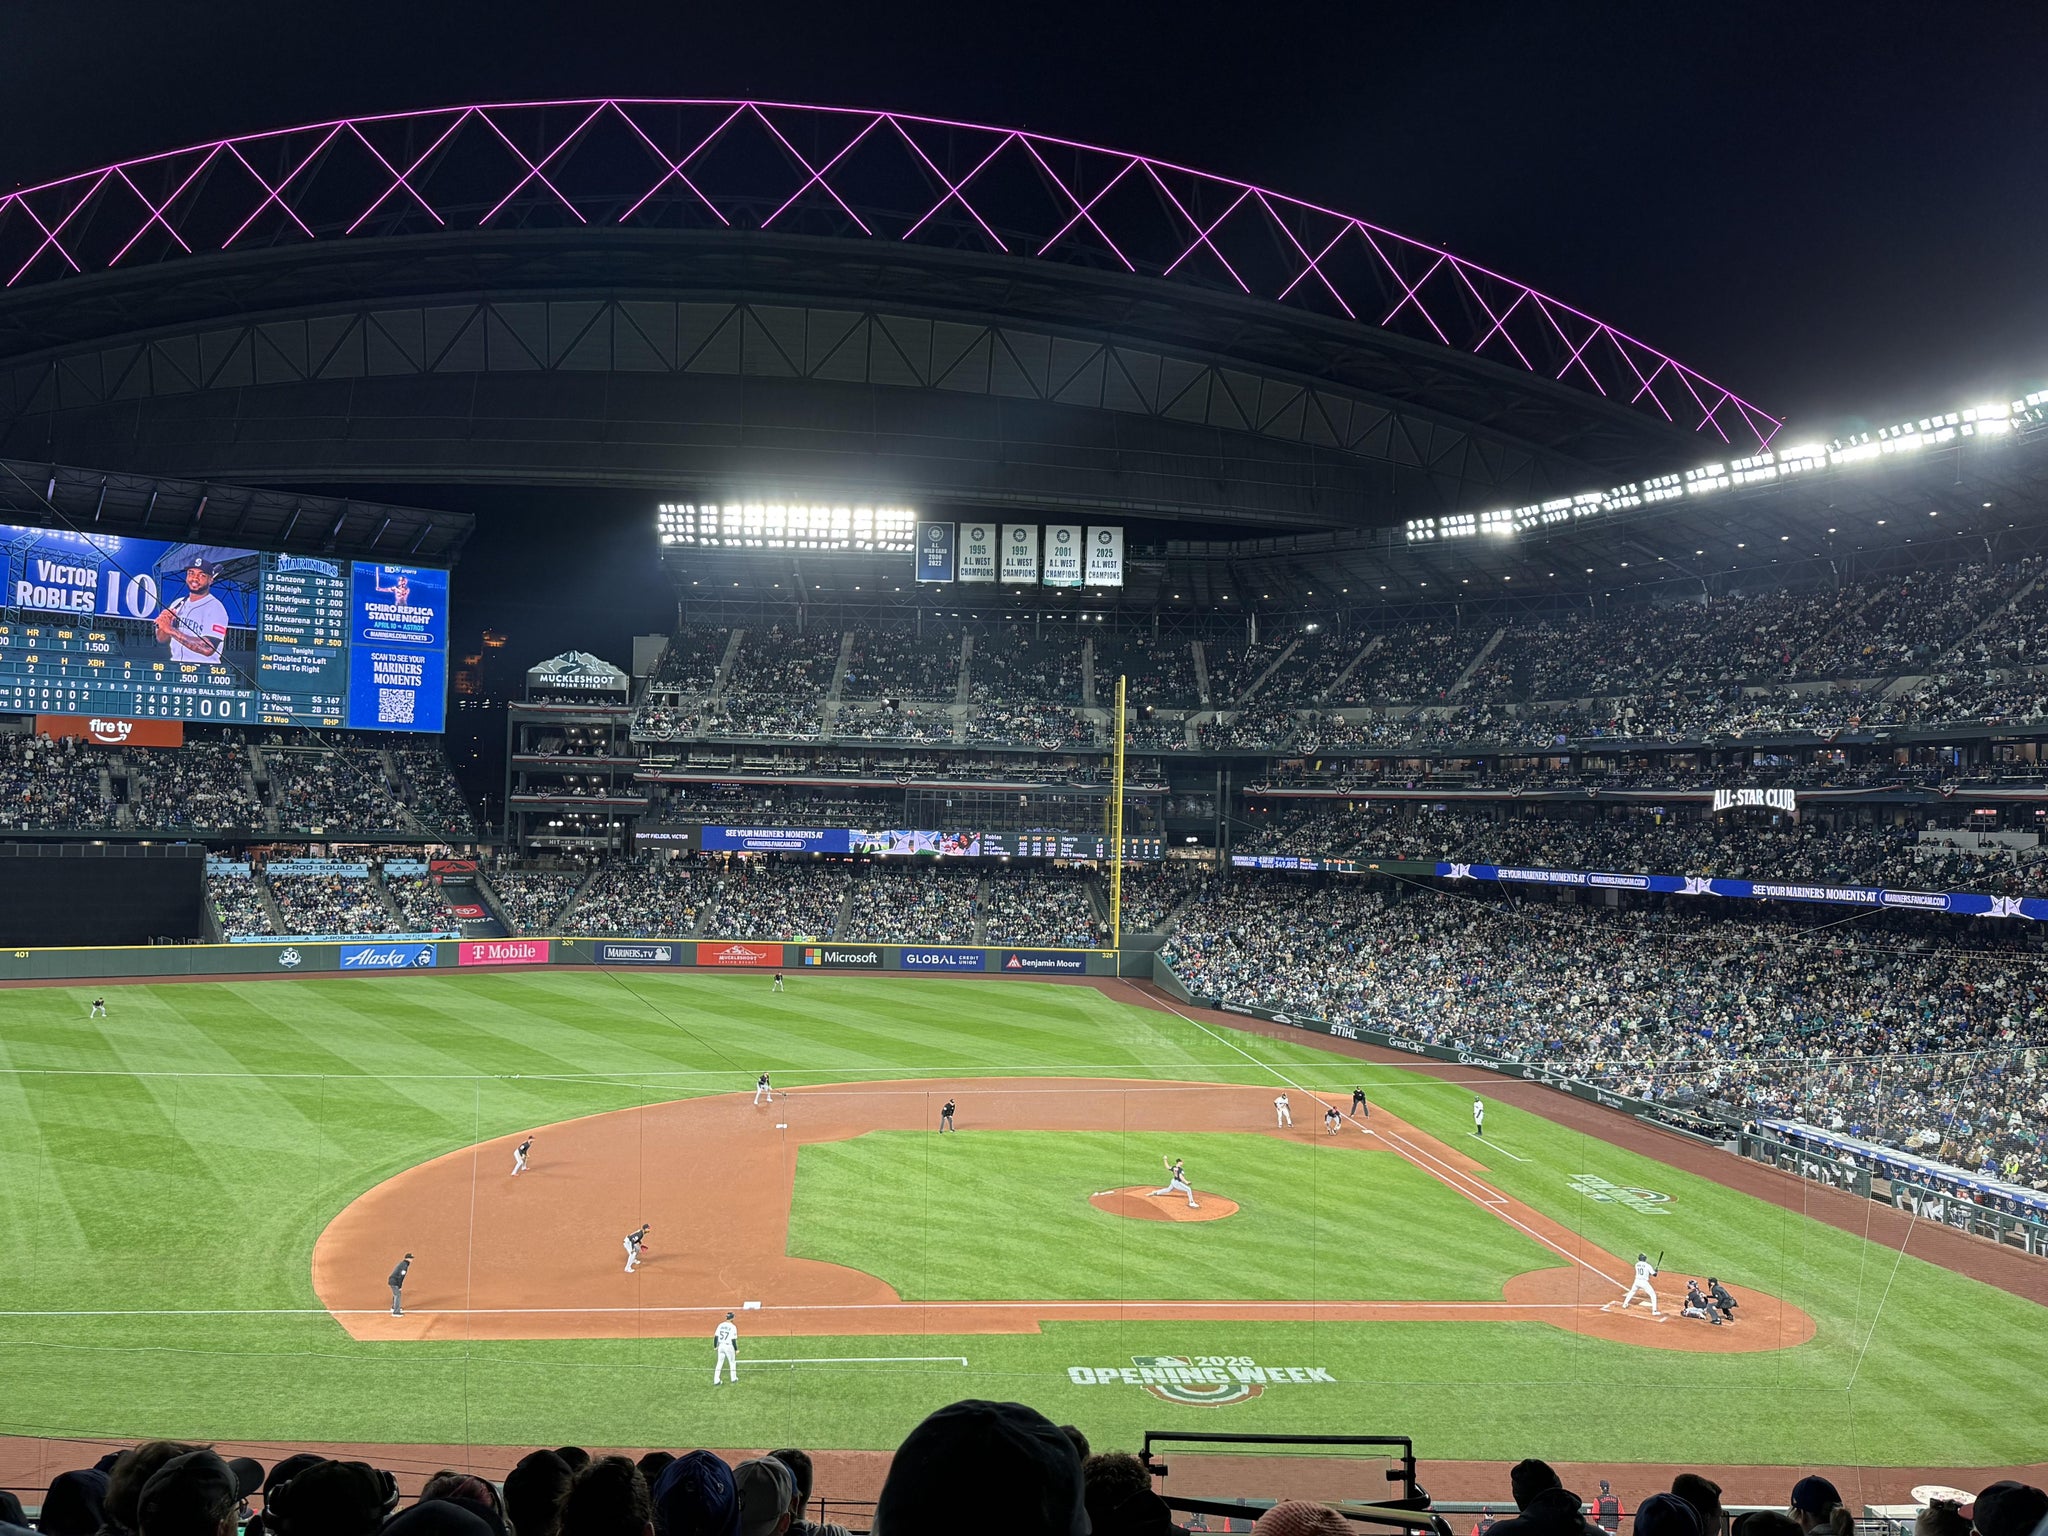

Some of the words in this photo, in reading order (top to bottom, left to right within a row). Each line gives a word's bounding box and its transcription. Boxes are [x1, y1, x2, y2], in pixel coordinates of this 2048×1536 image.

[969, 545, 986, 554] 1995
[1012, 546, 1028, 555] 1997
[1055, 547, 1071, 556] 2001
[1096, 548, 1113, 557] 2025
[975, 557, 991, 565] WEST
[1017, 558, 1032, 566] WEST
[1060, 559, 1075, 568] WEST
[1102, 560, 1117, 568] WEST
[277, 556, 338, 578] MARINERS
[960, 568, 993, 576] CHAMPIONS
[37, 559, 97, 588] VICTOR
[1002, 569, 1035, 577] CHAMPIONS
[1045, 570, 1078, 579] CHAMPIONS
[1088, 571, 1119, 579] CHAMPIONS
[276, 575, 305, 584] Canzone
[104, 570, 157, 618] 10
[275, 585, 302, 594] Raleigh
[16, 580, 95, 612] ROBLES
[275, 605, 298, 613] Naylor
[365, 603, 397, 613] ICHIRO
[397, 605, 434, 616] REPLICA
[274, 615, 311, 624] Arozarena
[368, 611, 401, 622] STATUE
[402, 614, 430, 624] NIGHT
[274, 625, 304, 634] Donovan
[374, 621, 389, 629] APRIL
[26, 628, 39, 637] HR
[58, 630, 73, 639] RBI
[88, 633, 106, 641] OPS
[274, 635, 298, 643] Robles
[84, 642, 110, 652] 1.500
[292, 647, 314, 655] Tonight
[273, 655, 301, 663] Doubled
[371, 652, 388, 661] SCAN
[397, 655, 409, 663] SEE
[409, 655, 425, 664] YOUR
[26, 655, 38, 663] AB
[87, 659, 105, 667] XBH
[180, 665, 197, 673] OBP
[210, 666, 226, 675] SLG
[373, 661, 423, 675] MARINERS
[179, 674, 198, 683] .500
[207, 676, 231, 685] 1.000
[373, 673, 422, 686] MOMENTS
[539, 674, 615, 684] MUCKLESHOOT
[271, 694, 291, 702] Rivas
[201, 699, 212, 716] 0
[219, 700, 231, 717] 0
[239, 701, 247, 718] 1
[89, 719, 115, 732] fire
[116, 721, 133, 733] tv
[1766, 789, 1796, 811] CLUB
[725, 829, 737, 837] SEE
[737, 829, 753, 837] YOUR
[753, 830, 784, 838] MARINERS
[785, 830, 816, 838] MOMENTS
[1498, 869, 1508, 878] SEE
[1508, 870, 1521, 879] YOUR
[1521, 871, 1549, 881] MARINERS
[1550, 872, 1577, 883] MOMENTS
[1577, 874, 1586, 883] AT
[1752, 885, 1766, 895] SEE
[1766, 885, 1785, 896] YOUR
[1785, 886, 1825, 899] MARINERS
[1825, 889, 1866, 901] MOMENTS
[1866, 891, 1877, 902] AT
[1885, 894, 1946, 906] MARINERS.FANCAM.COM
[283, 951, 298, 960] 50
[472, 945, 485, 959] T
[488, 944, 536, 958] Mobile
[345, 948, 405, 967] Alaska
[824, 952, 877, 963] Microsoft
[906, 954, 956, 964] GLOBAL
[1022, 959, 1055, 968] Benjamin
[1056, 960, 1081, 968] Moore
[1330, 1024, 1358, 1039] STIHL
[1388, 1037, 1408, 1049] Great
[1408, 1041, 1425, 1053] Clips
[1469, 1056, 1499, 1069] LEXUS
[1637, 1268, 1644, 1276] 10
[719, 1331, 729, 1340] 57
[1194, 1356, 1256, 1367] 2026
[1067, 1366, 1230, 1385] OPENING
[1230, 1366, 1337, 1384] WEEK
